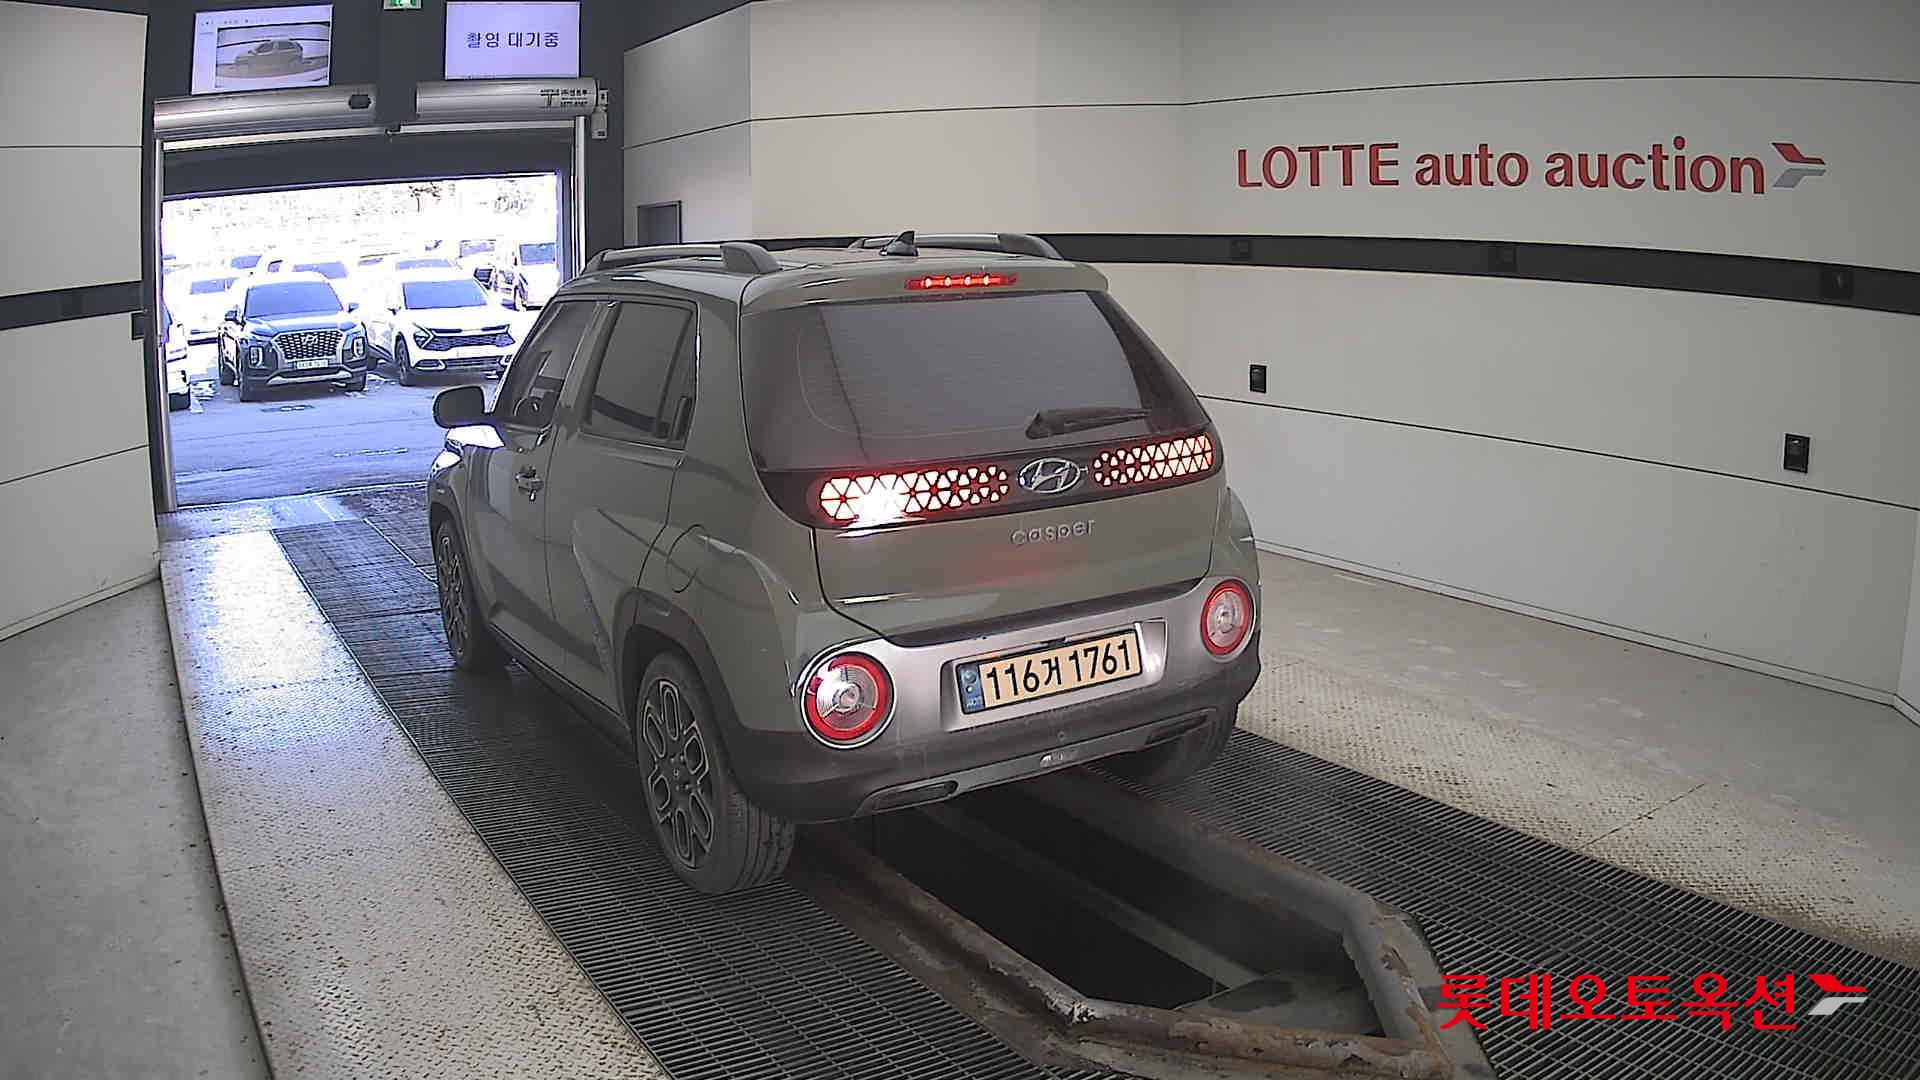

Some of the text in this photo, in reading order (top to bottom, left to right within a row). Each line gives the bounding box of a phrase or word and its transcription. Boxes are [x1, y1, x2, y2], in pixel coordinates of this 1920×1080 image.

[507, 31, 560, 49] 대기중
[1237, 136, 1765, 194] LOTTE auto auction
[1010, 519, 1095, 545] casper
